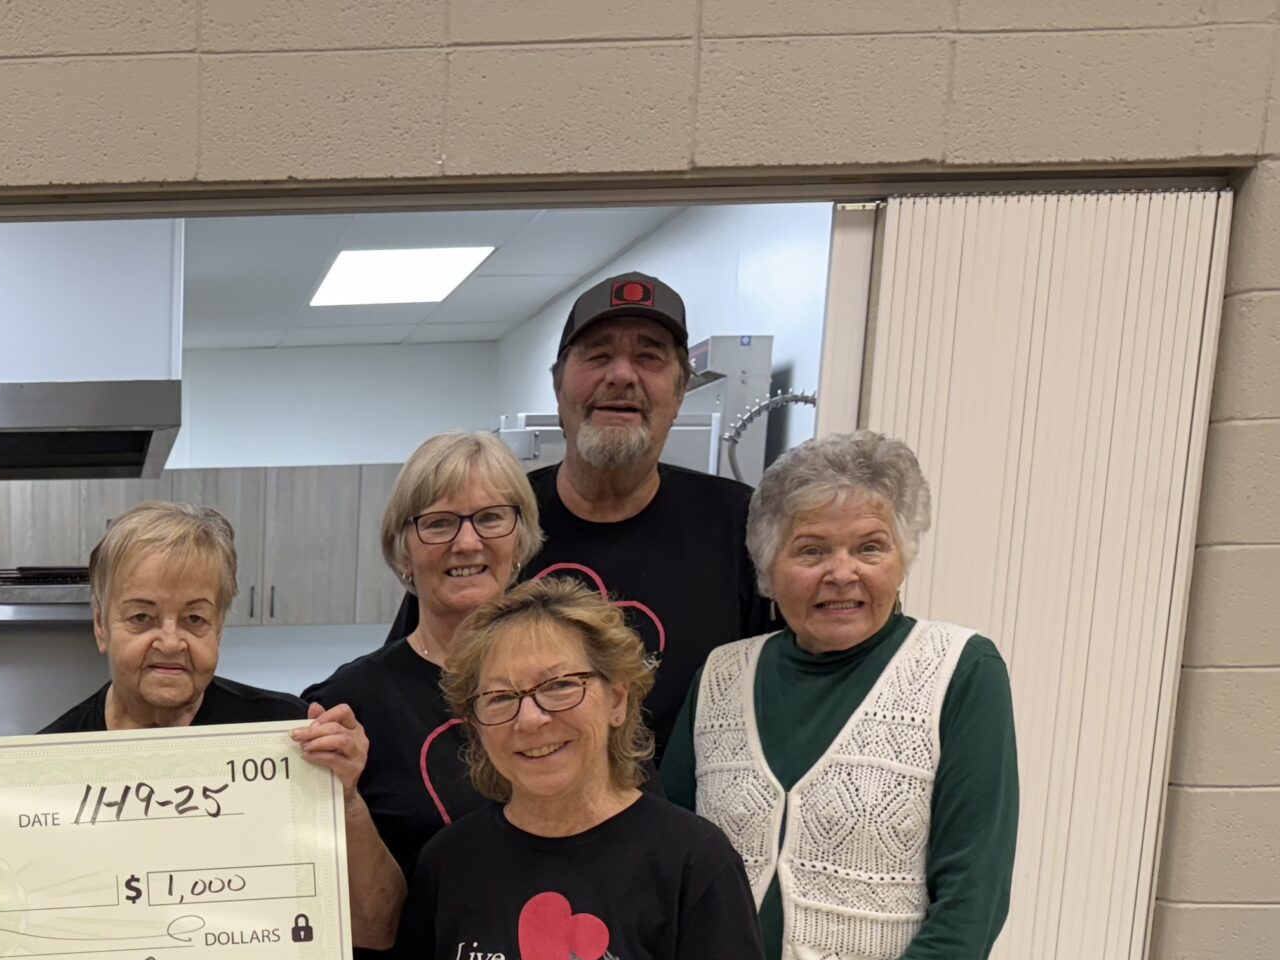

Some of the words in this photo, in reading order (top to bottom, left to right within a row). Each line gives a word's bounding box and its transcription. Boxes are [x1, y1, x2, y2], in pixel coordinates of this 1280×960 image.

[226, 756, 290, 783] 1001
[18, 812, 61, 829] DATE
[124, 874, 143, 904] $
[167, 873, 247, 904] 1,000
[204, 928, 282, 947] DOLLARS
